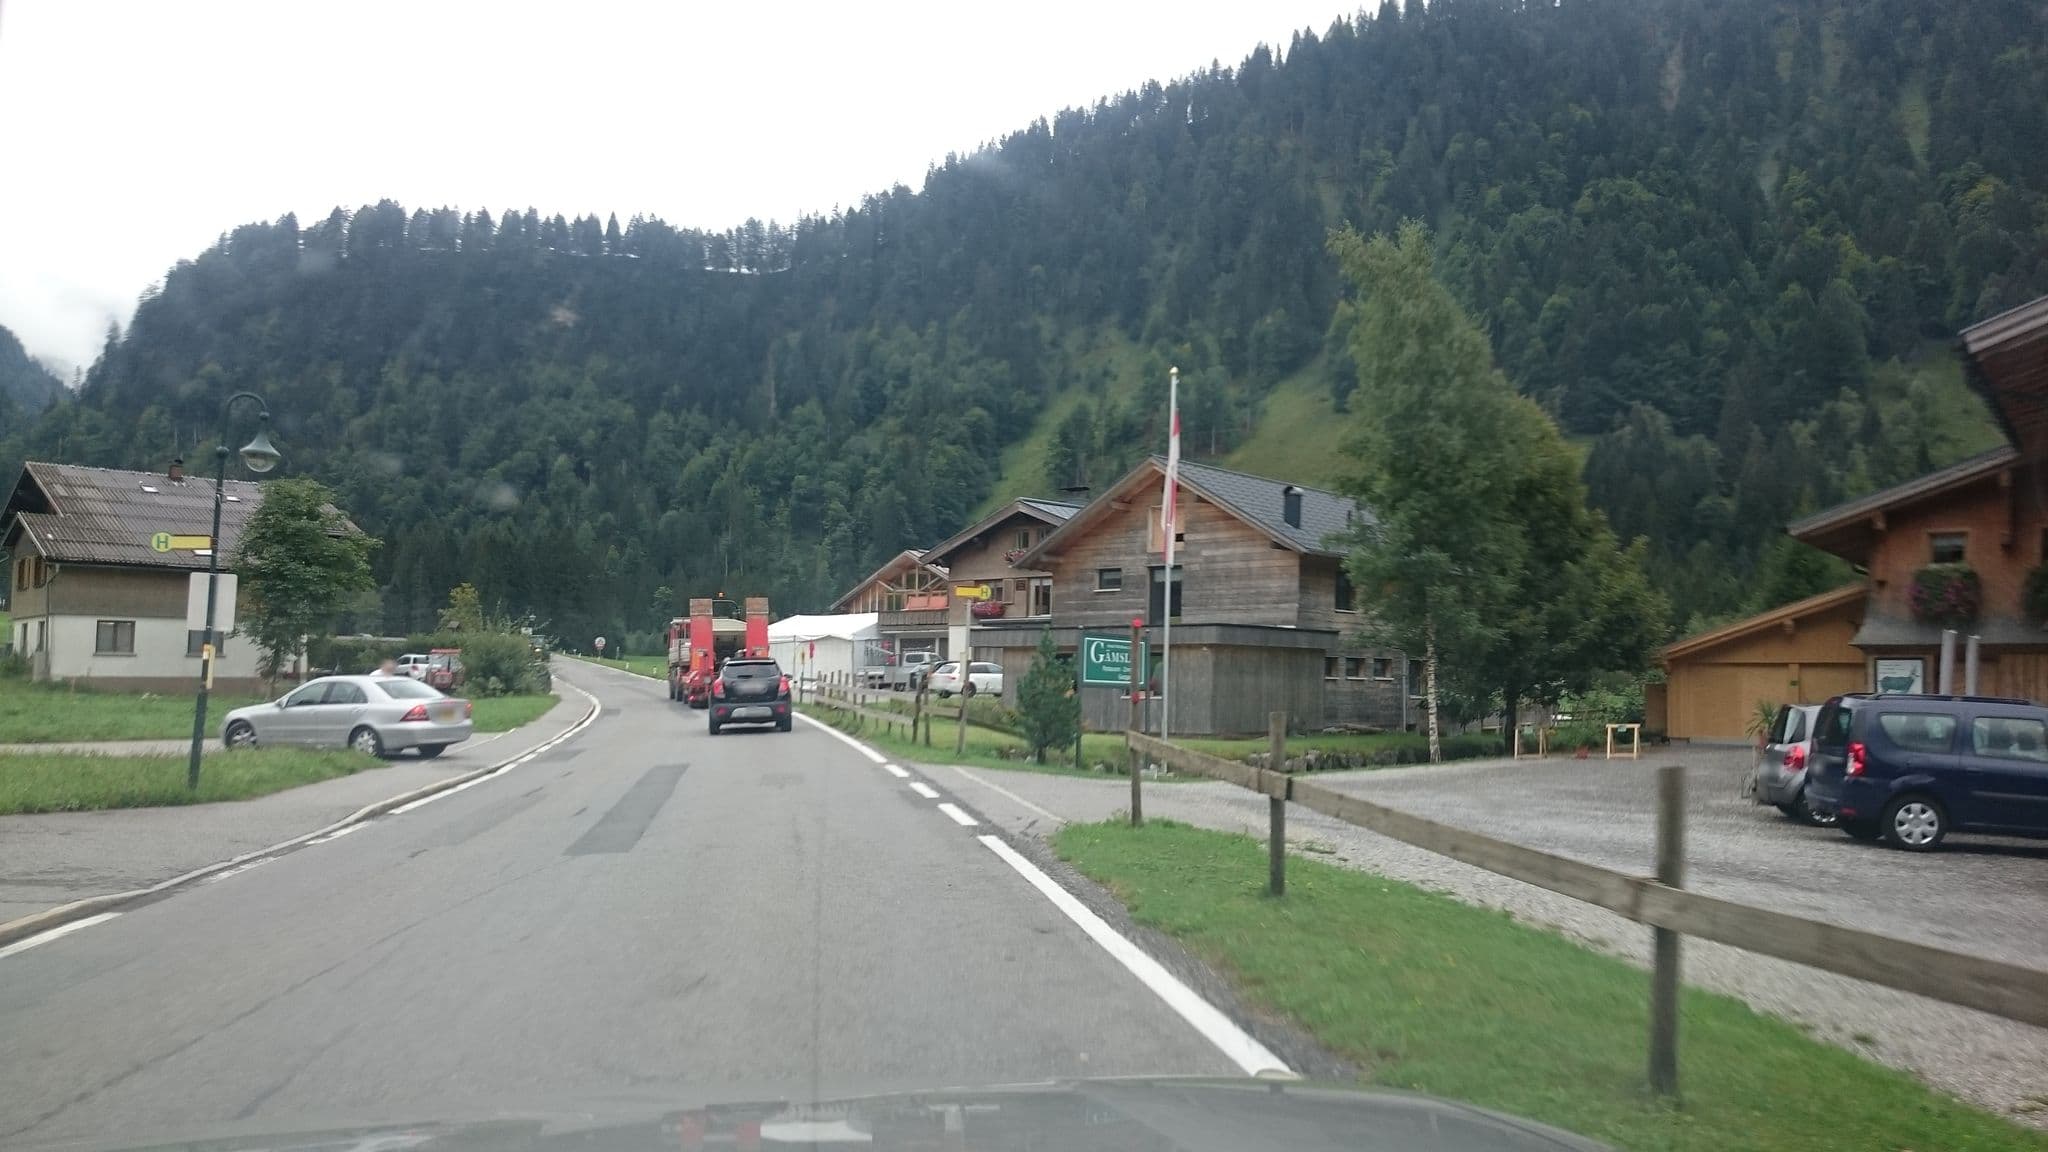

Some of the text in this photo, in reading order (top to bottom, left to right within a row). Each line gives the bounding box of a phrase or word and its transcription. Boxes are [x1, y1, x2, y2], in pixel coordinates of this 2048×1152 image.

[156, 535, 169, 549] H
[980, 587, 989, 598] H
[1090, 640, 1133, 663] GÄMSL
